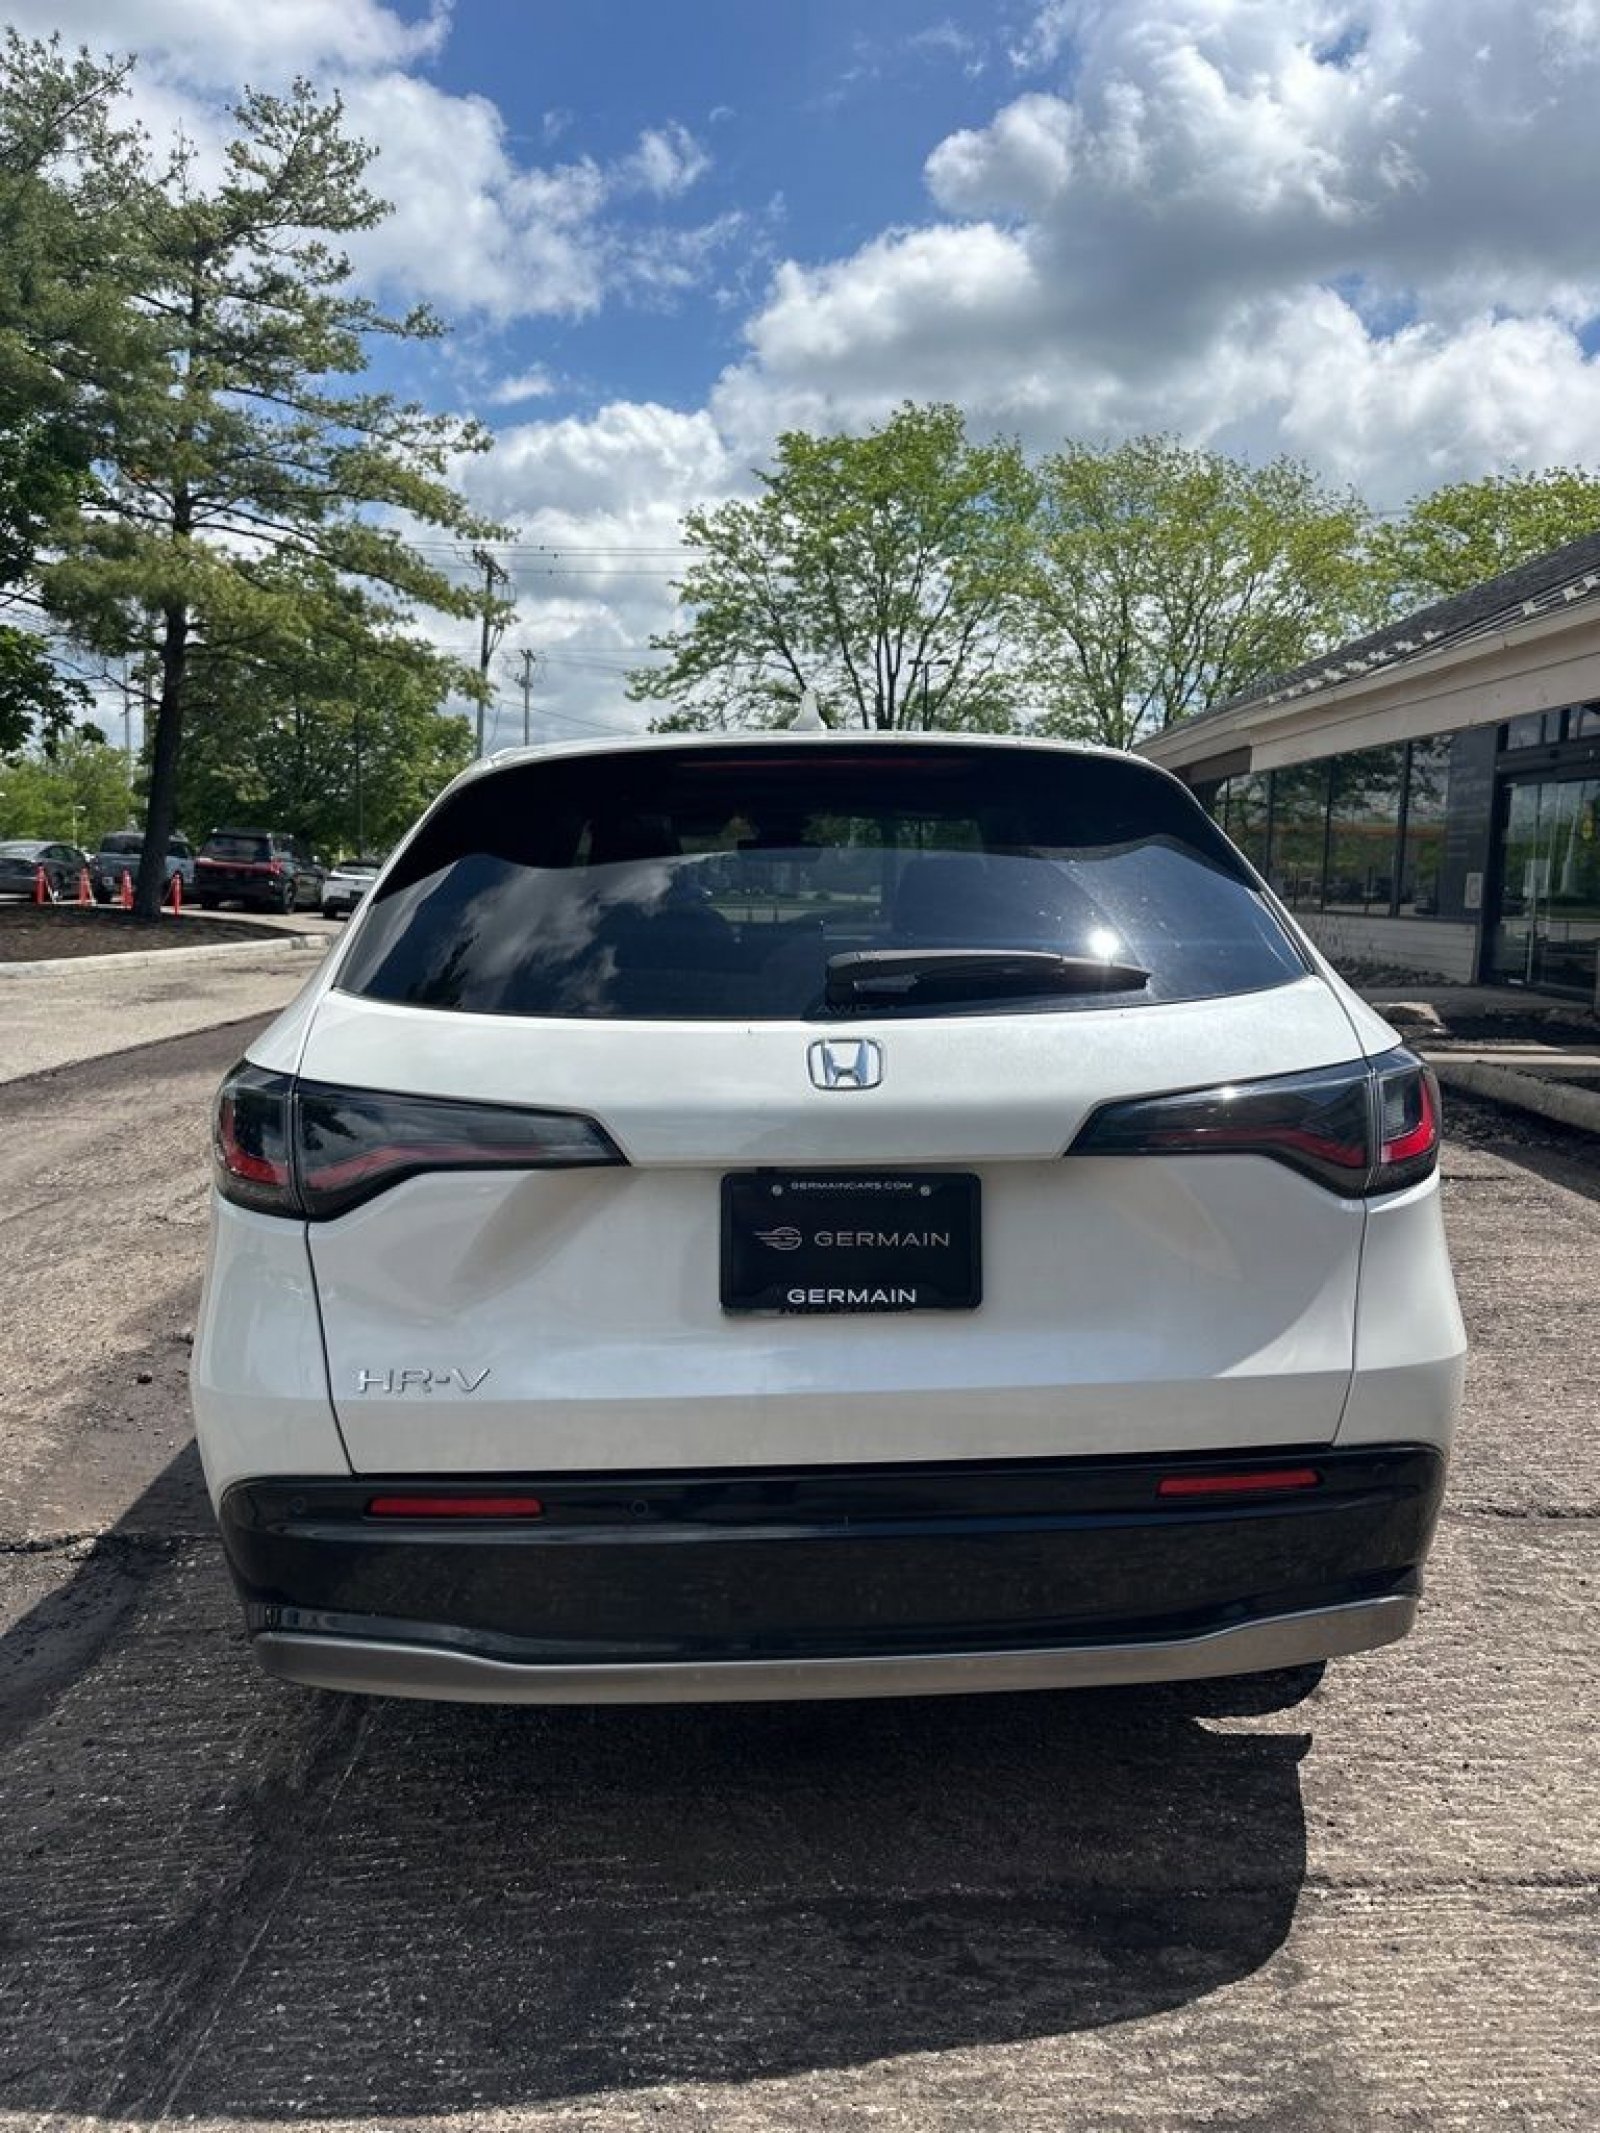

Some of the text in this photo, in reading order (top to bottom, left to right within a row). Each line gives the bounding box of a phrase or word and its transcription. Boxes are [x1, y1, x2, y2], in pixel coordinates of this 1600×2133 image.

[791, 1181, 913, 1190] GERMAINCARS.COM
[814, 1232, 950, 1247] GERMAIN
[786, 1288, 917, 1304] GERMAIN
[357, 1368, 491, 1394] HR-V
